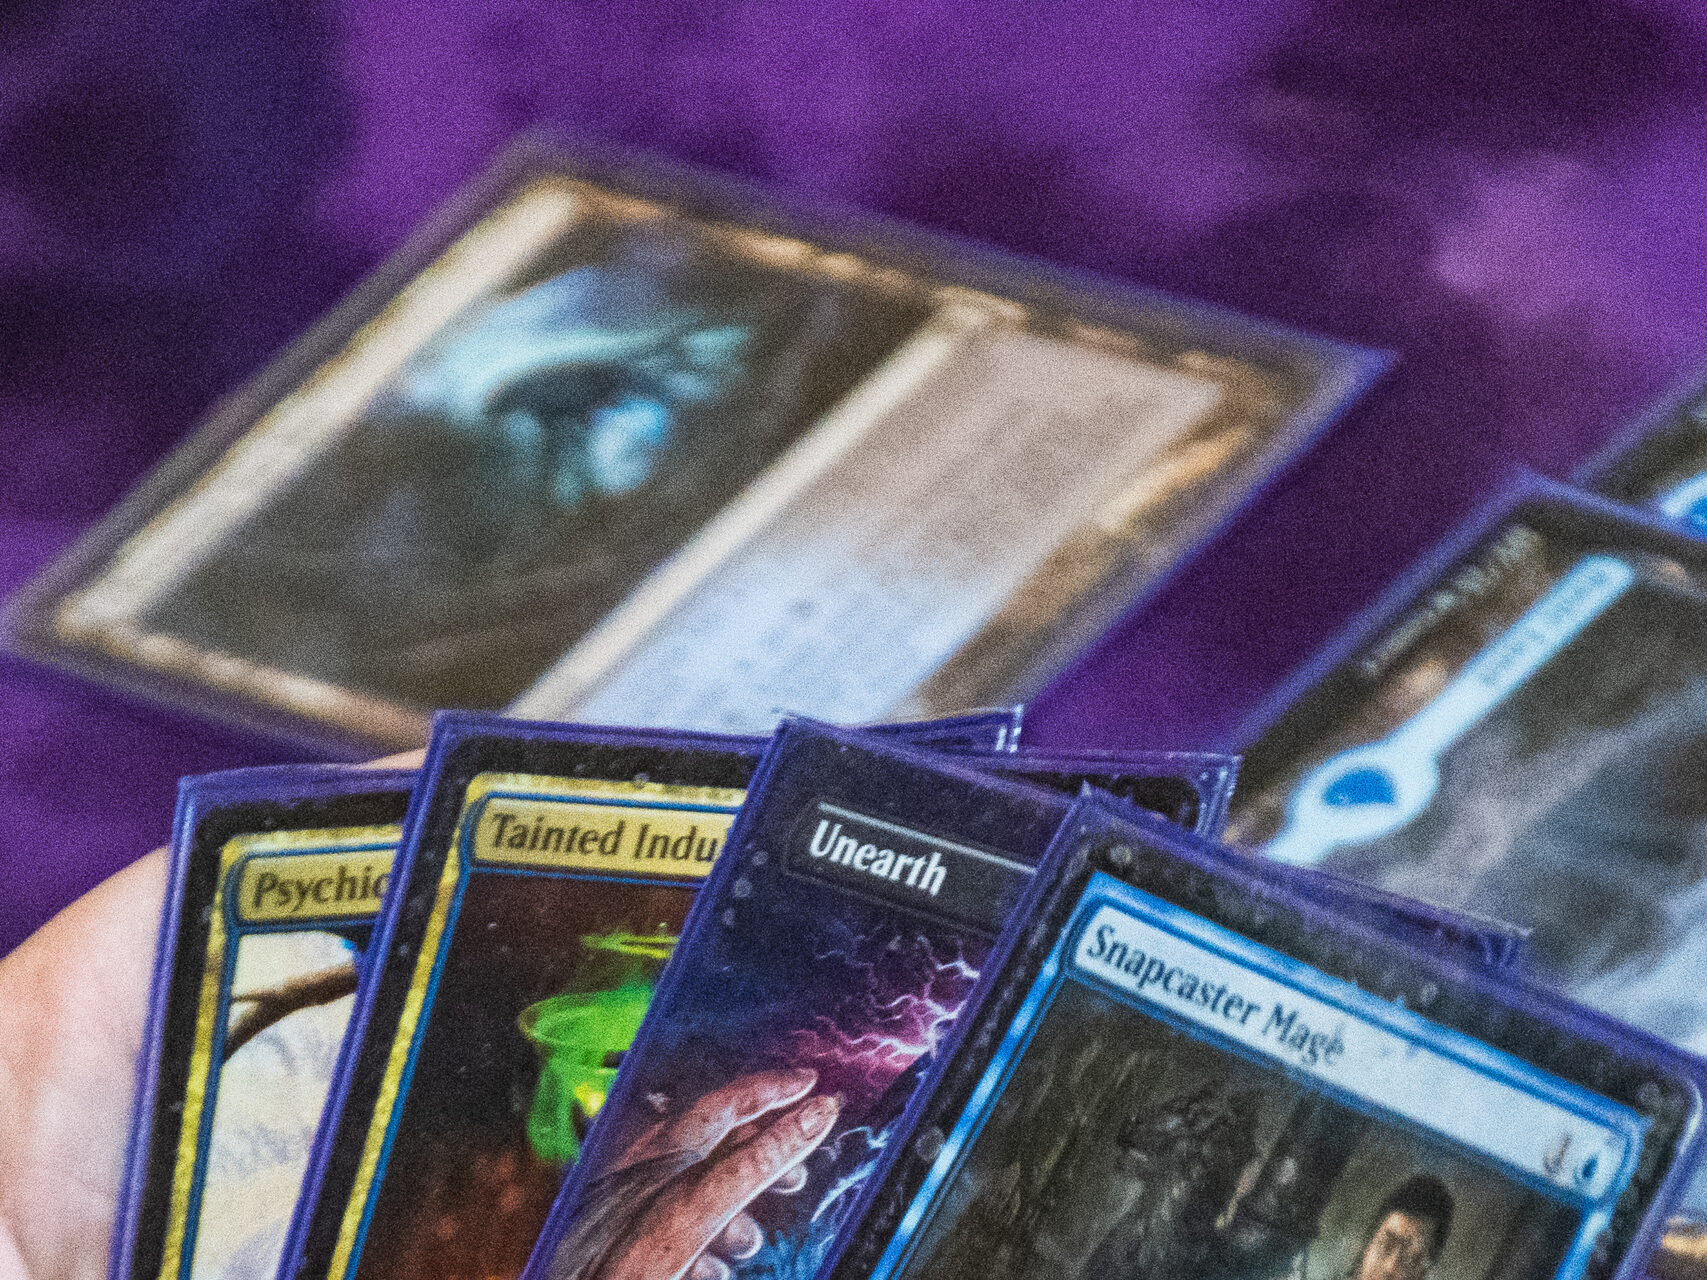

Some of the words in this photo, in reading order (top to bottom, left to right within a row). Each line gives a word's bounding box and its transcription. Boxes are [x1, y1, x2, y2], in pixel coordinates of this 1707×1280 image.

[491, 811, 621, 858] Tainted
[809, 819, 948, 898] Unearth
[1086, 923, 1261, 1025] Snapcaster
[1263, 1003, 1346, 1067] Mage
